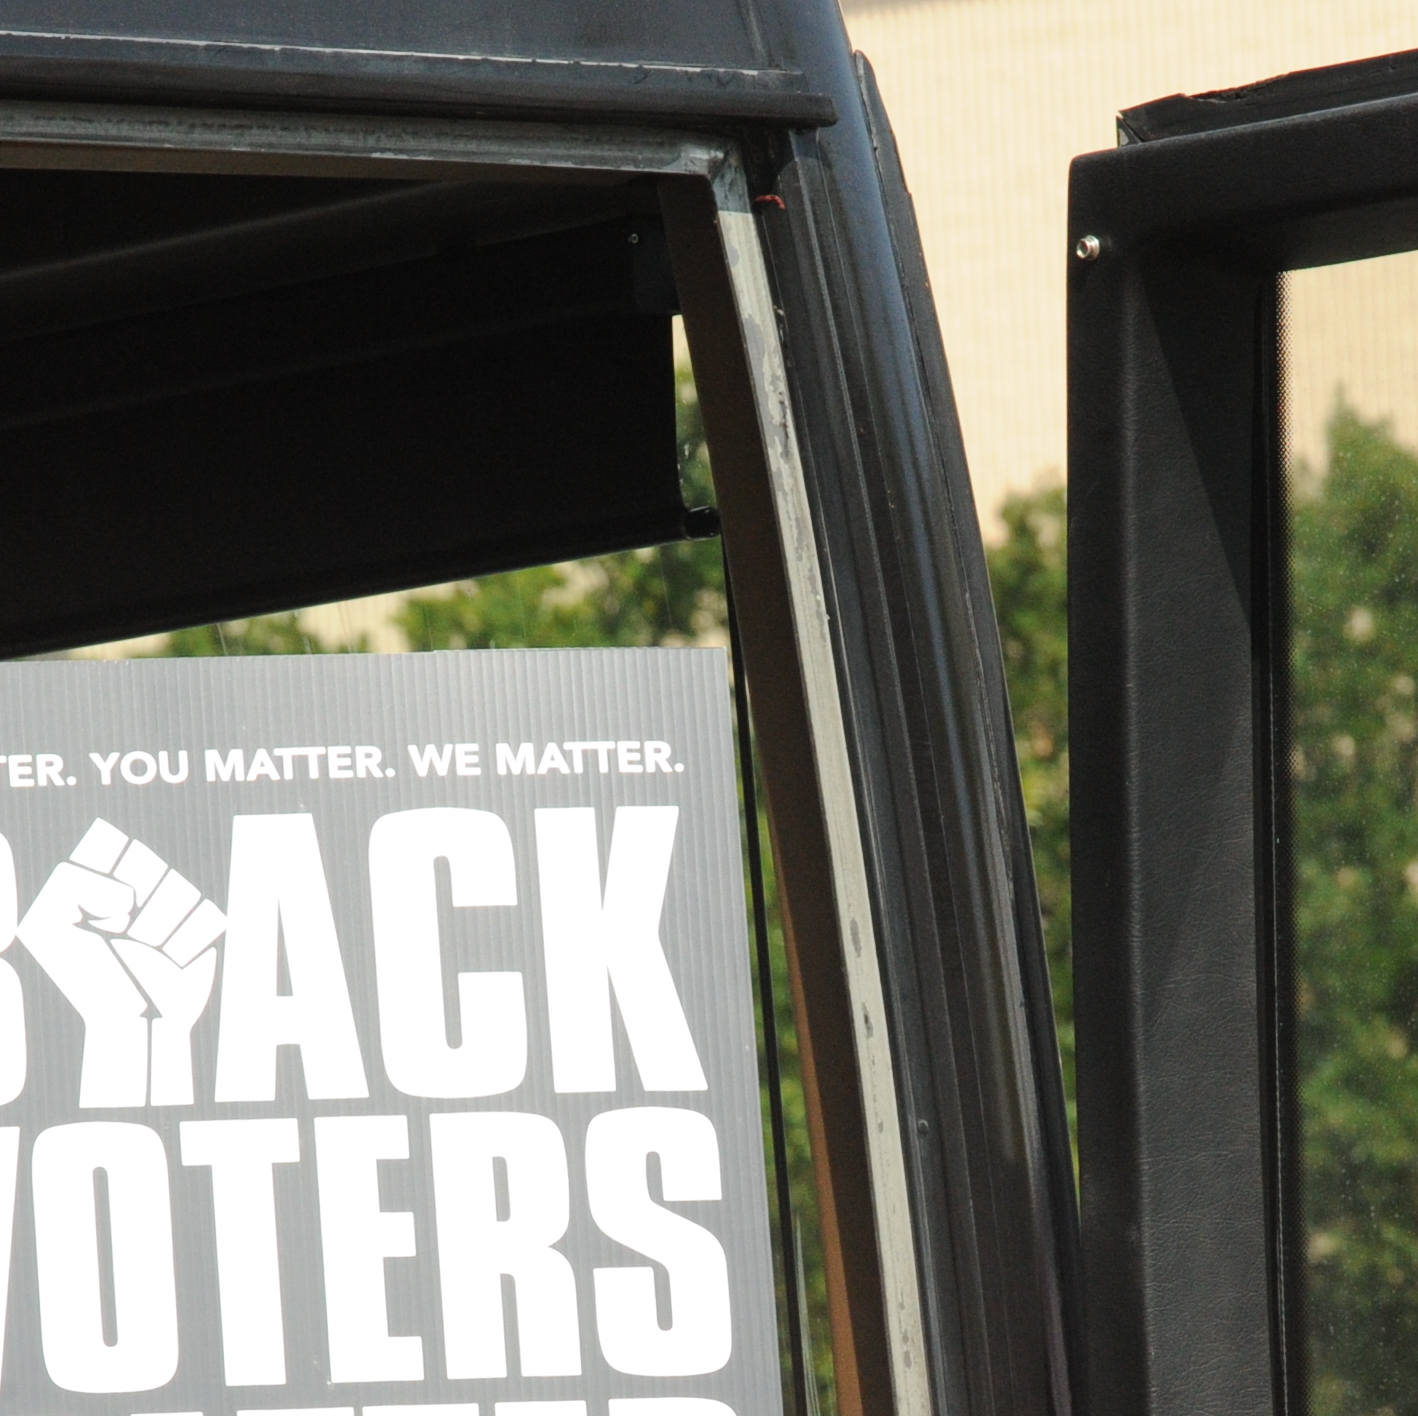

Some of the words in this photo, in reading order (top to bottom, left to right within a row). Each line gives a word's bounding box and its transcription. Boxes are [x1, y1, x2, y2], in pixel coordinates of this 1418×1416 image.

[88, 750, 189, 785] YOU
[204, 745, 396, 782] MATTER.
[407, 742, 482, 777] WE
[495, 740, 685, 776] MATTER.
